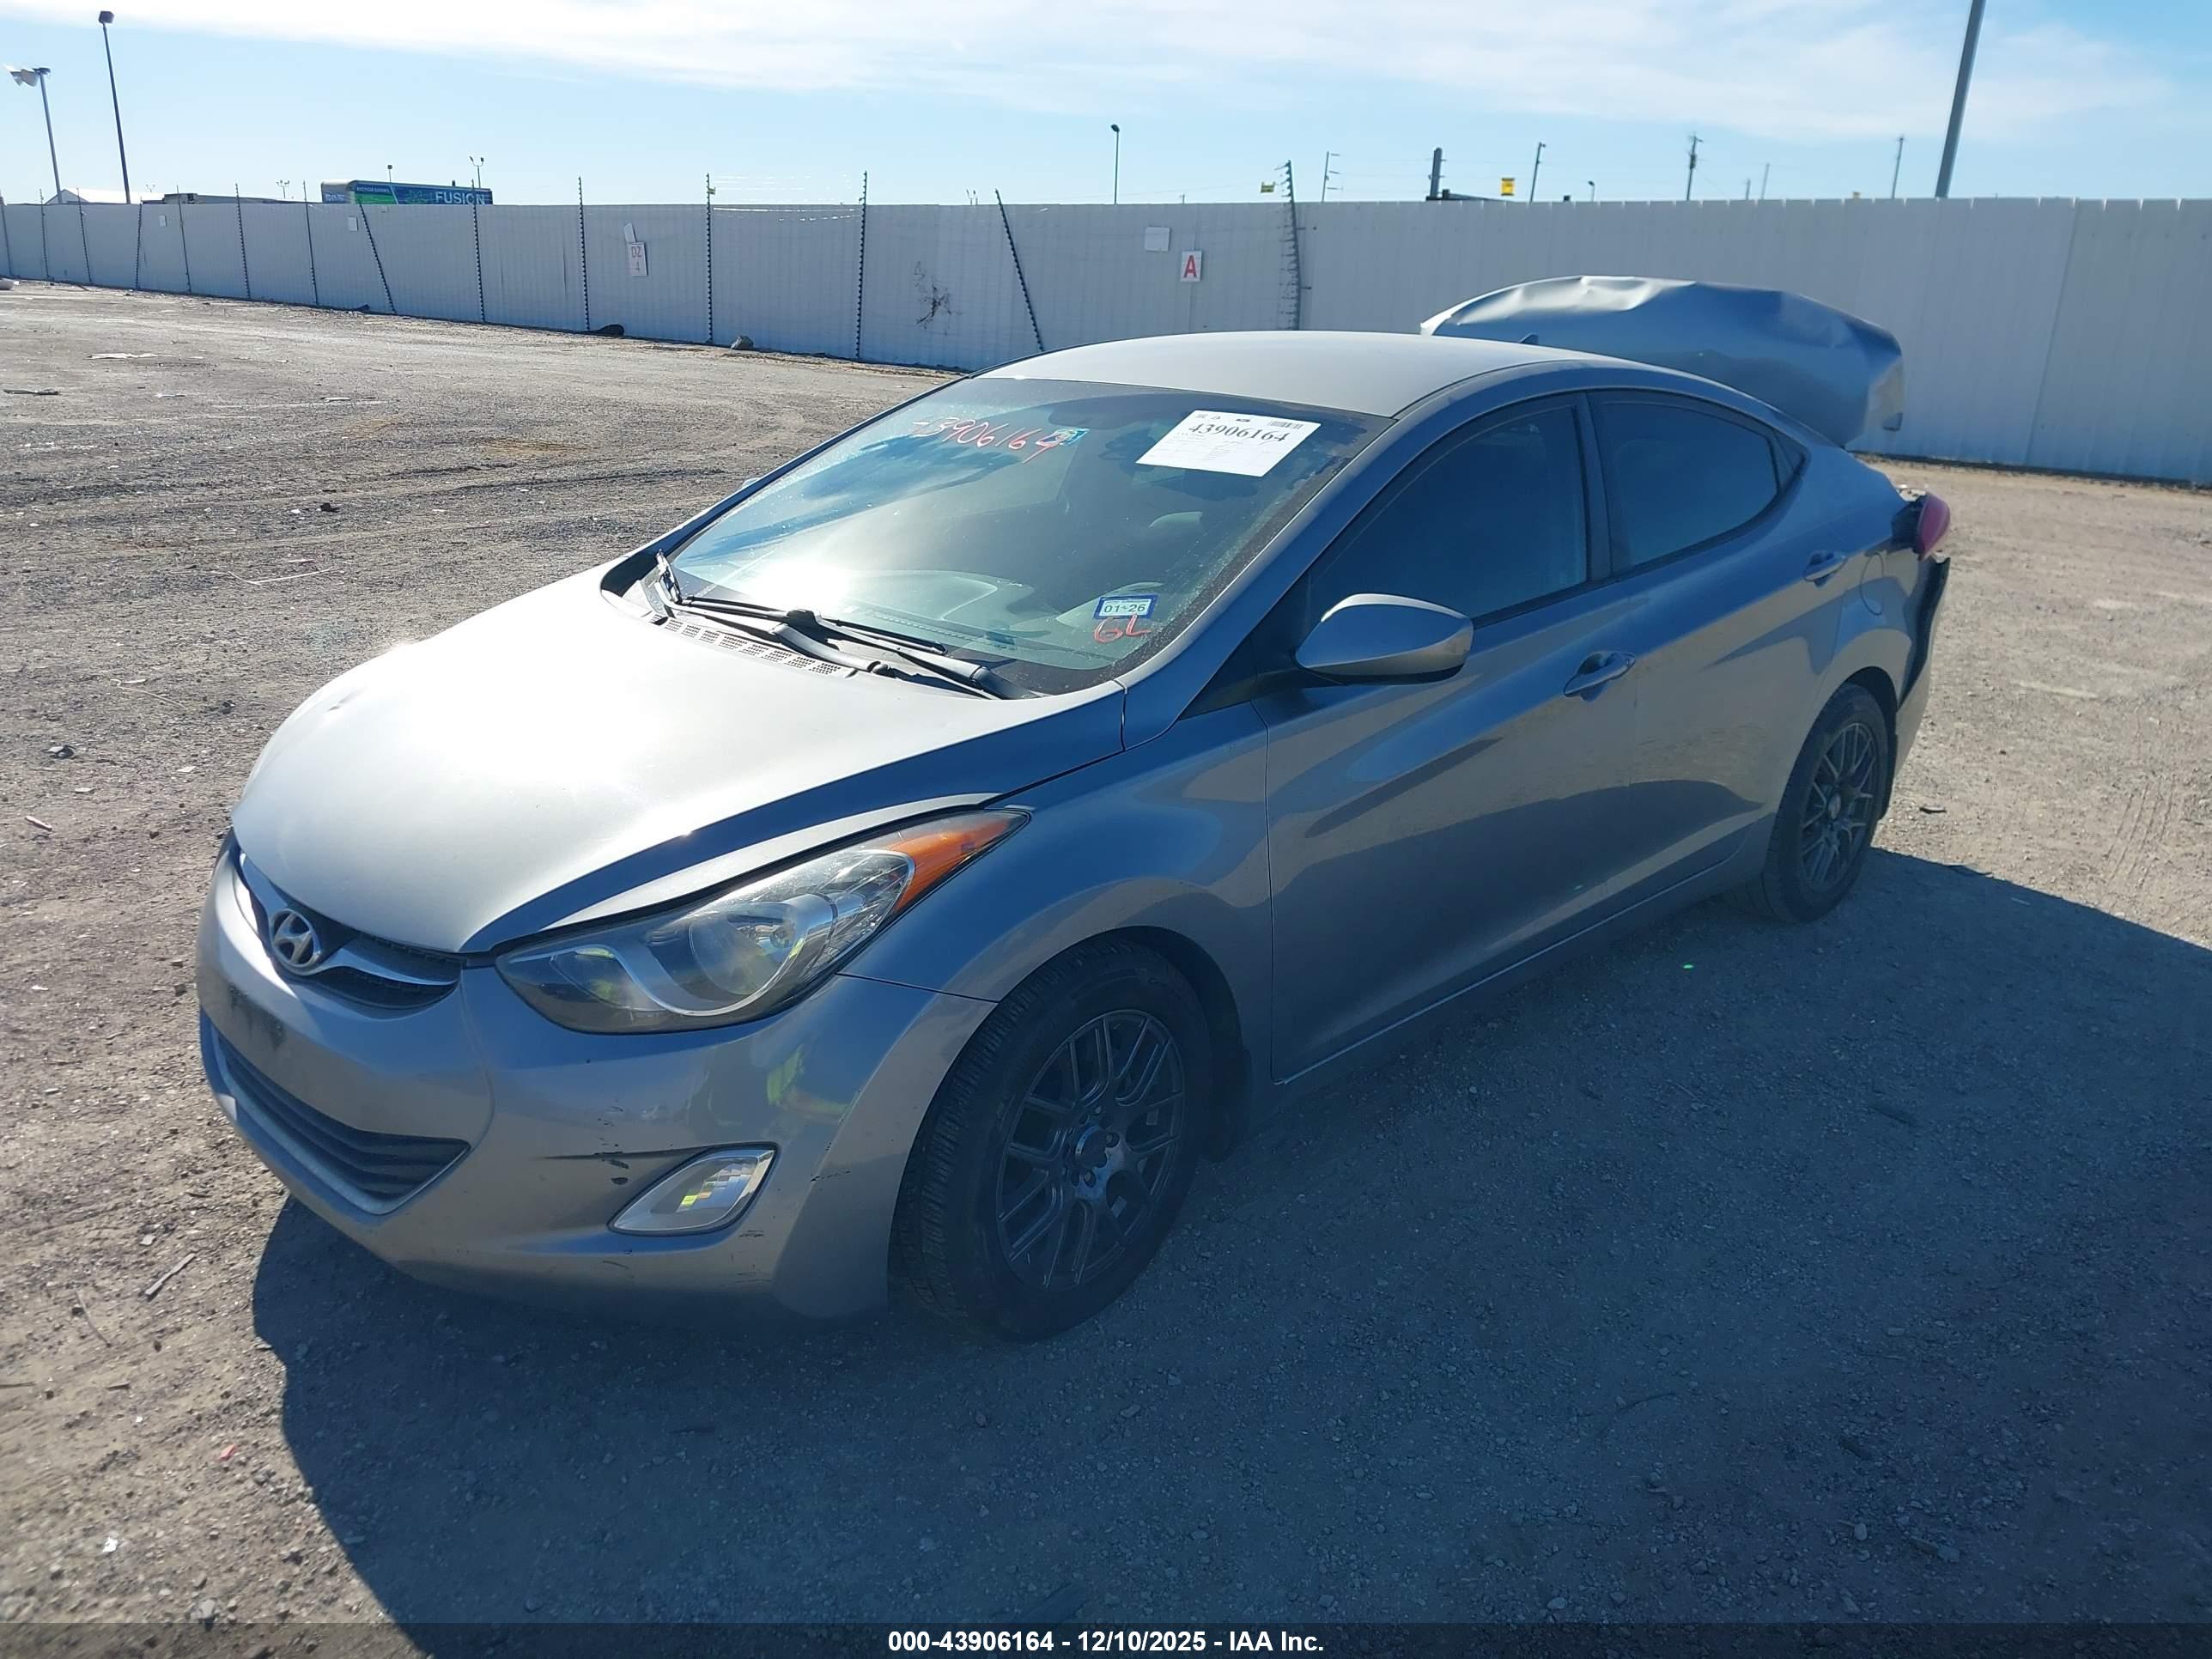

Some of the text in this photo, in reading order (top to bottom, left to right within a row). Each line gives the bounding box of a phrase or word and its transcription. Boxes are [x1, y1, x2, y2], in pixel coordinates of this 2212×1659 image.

[435, 191, 485, 206] FUSION
[1183, 254, 1198, 278] A
[1188, 422, 1291, 442] 43906164
